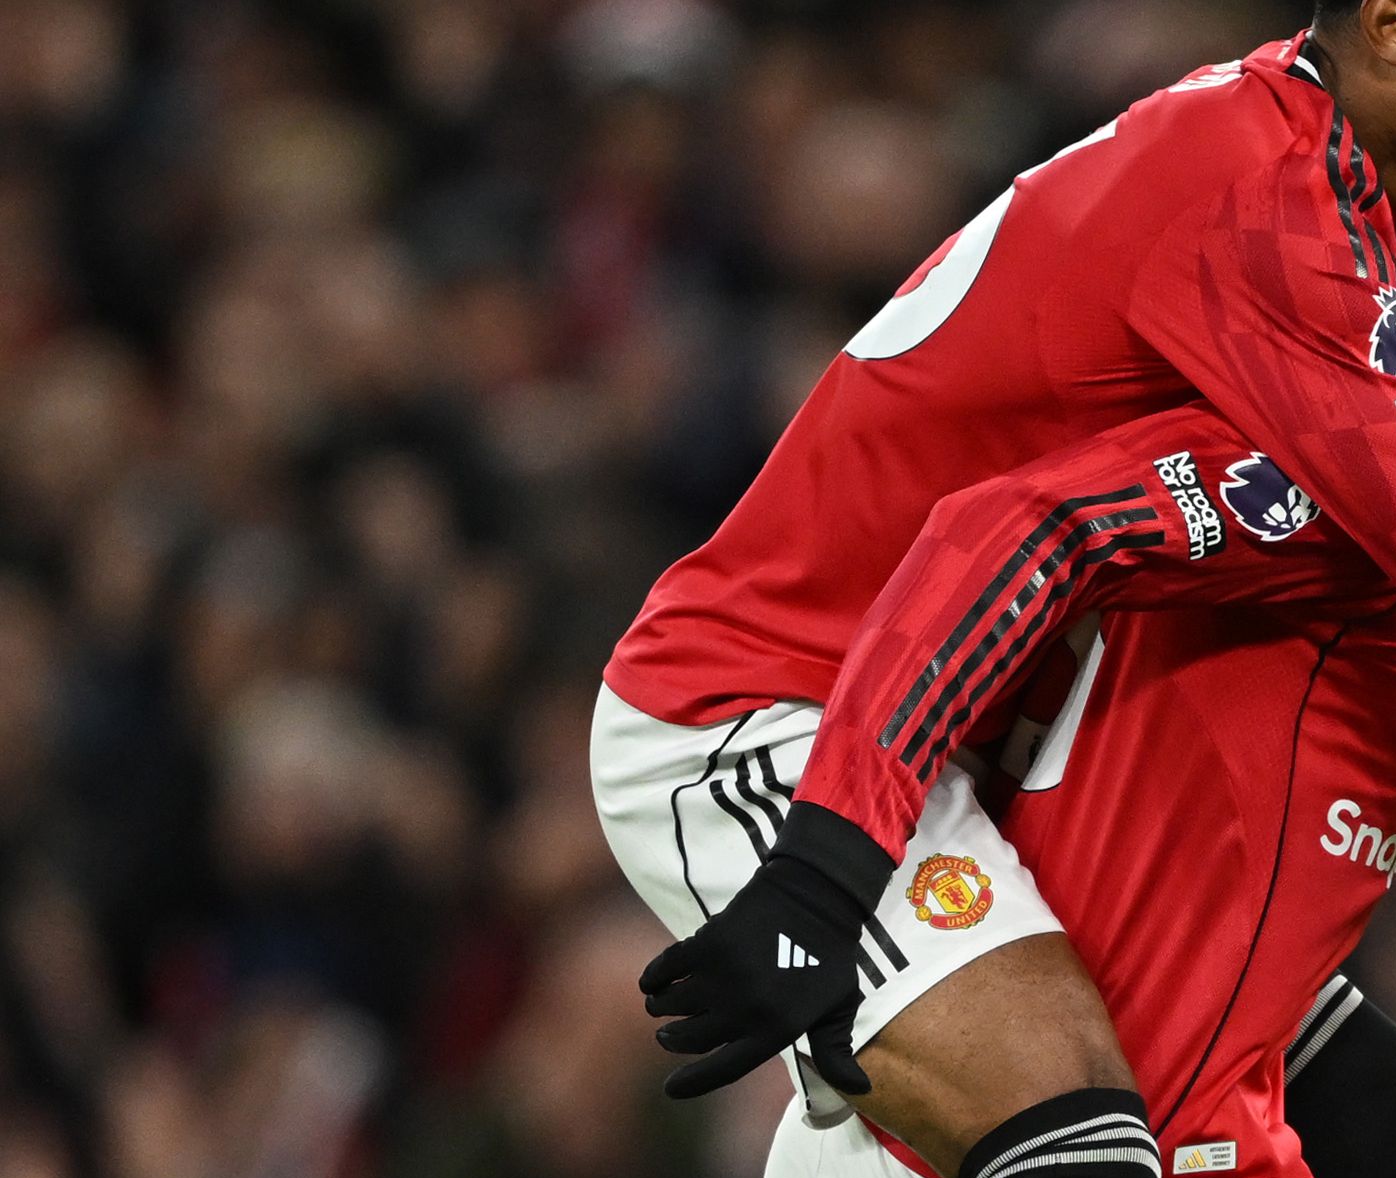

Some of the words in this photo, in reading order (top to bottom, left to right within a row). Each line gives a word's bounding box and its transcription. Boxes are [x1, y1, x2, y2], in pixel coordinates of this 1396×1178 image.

[1169, 451, 1196, 485] No
[1187, 487, 1222, 546] room
[1171, 489, 1205, 560] racism
[914, 859, 973, 900] MANCHESTER
[946, 900, 988, 927] UNITED
